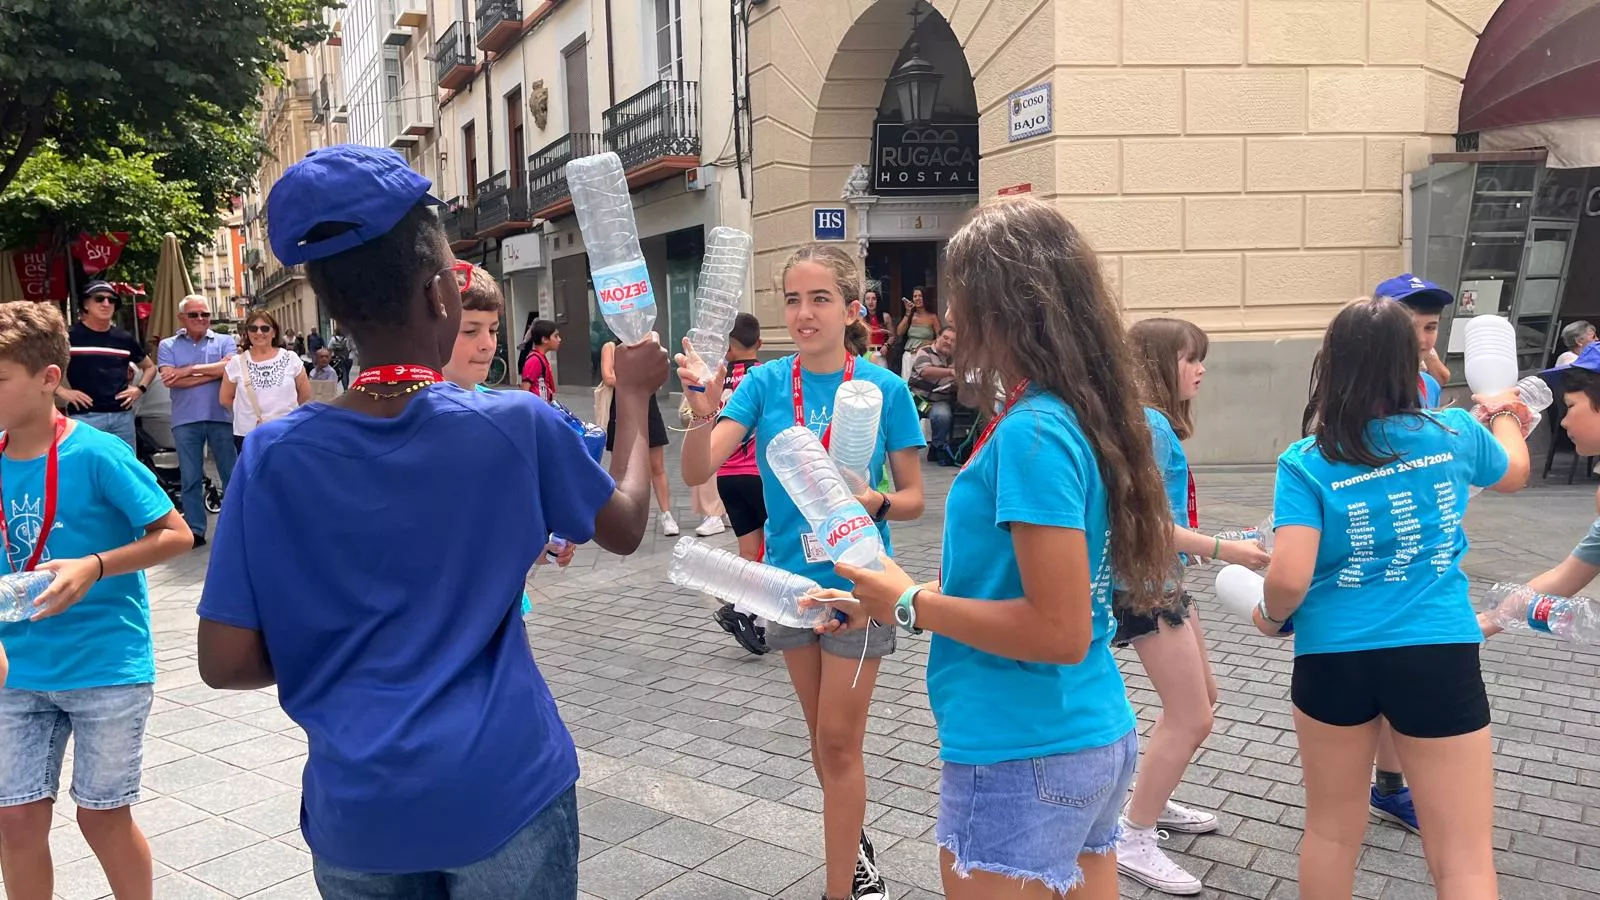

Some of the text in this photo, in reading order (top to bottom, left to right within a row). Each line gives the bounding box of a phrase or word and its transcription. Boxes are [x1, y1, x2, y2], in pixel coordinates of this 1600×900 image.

[1022, 95, 1044, 108] COSO
[1014, 115, 1045, 130] BAJO
[882, 147, 975, 167] RUGACA
[881, 171, 974, 182] HOSTAL
[818, 212, 842, 229] HS
[599, 280, 648, 302] BEZOYA
[1331, 452, 1453, 491] Promoción 2015/2024
[826, 515, 873, 547] BEZOYA
[1345, 526, 1375, 534] Cristian
